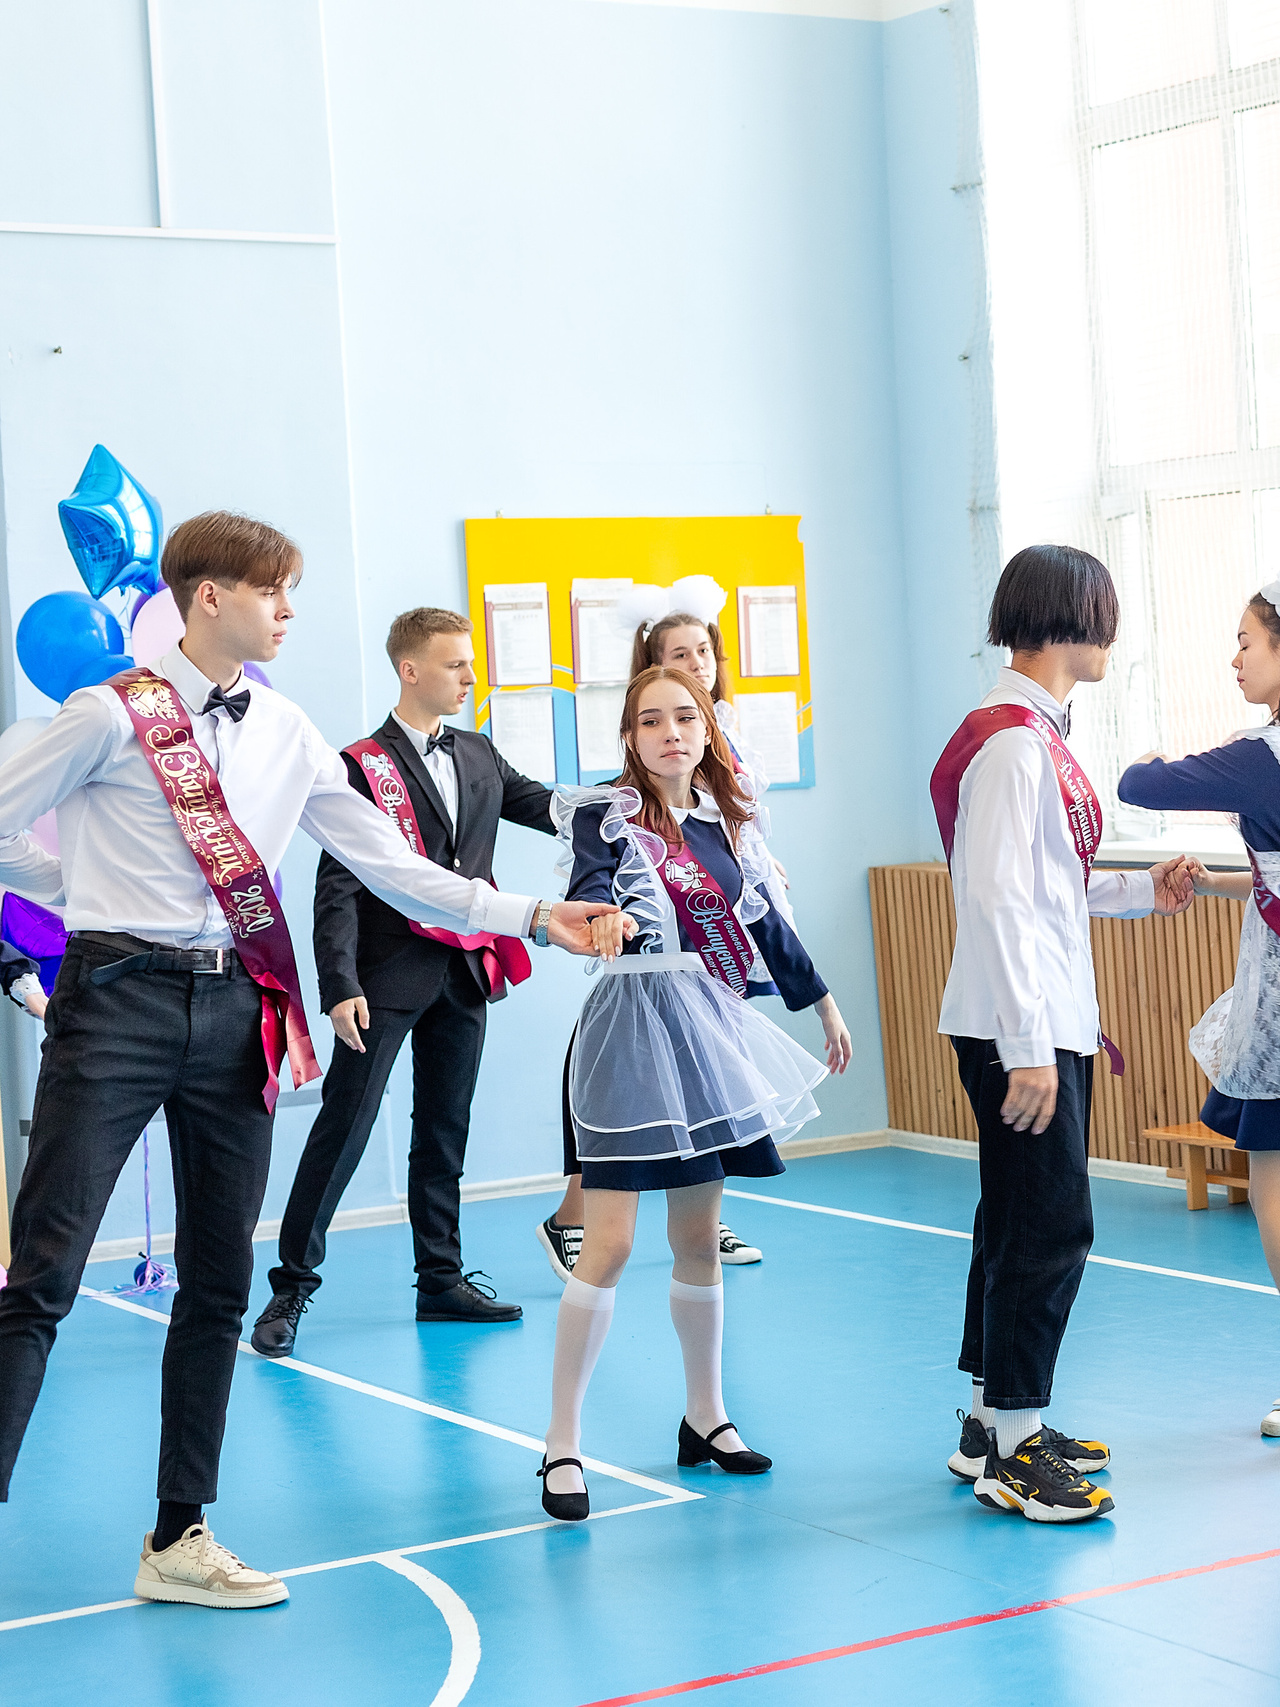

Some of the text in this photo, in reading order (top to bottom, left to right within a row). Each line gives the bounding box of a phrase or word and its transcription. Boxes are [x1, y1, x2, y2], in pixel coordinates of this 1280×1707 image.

[145, 724, 245, 888] Выпускник
[210, 795, 225, 820] Иван
[1051, 742, 1093, 851] Выпускник
[231, 884, 275, 934] 2020
[723, 919, 744, 951] Козлова
